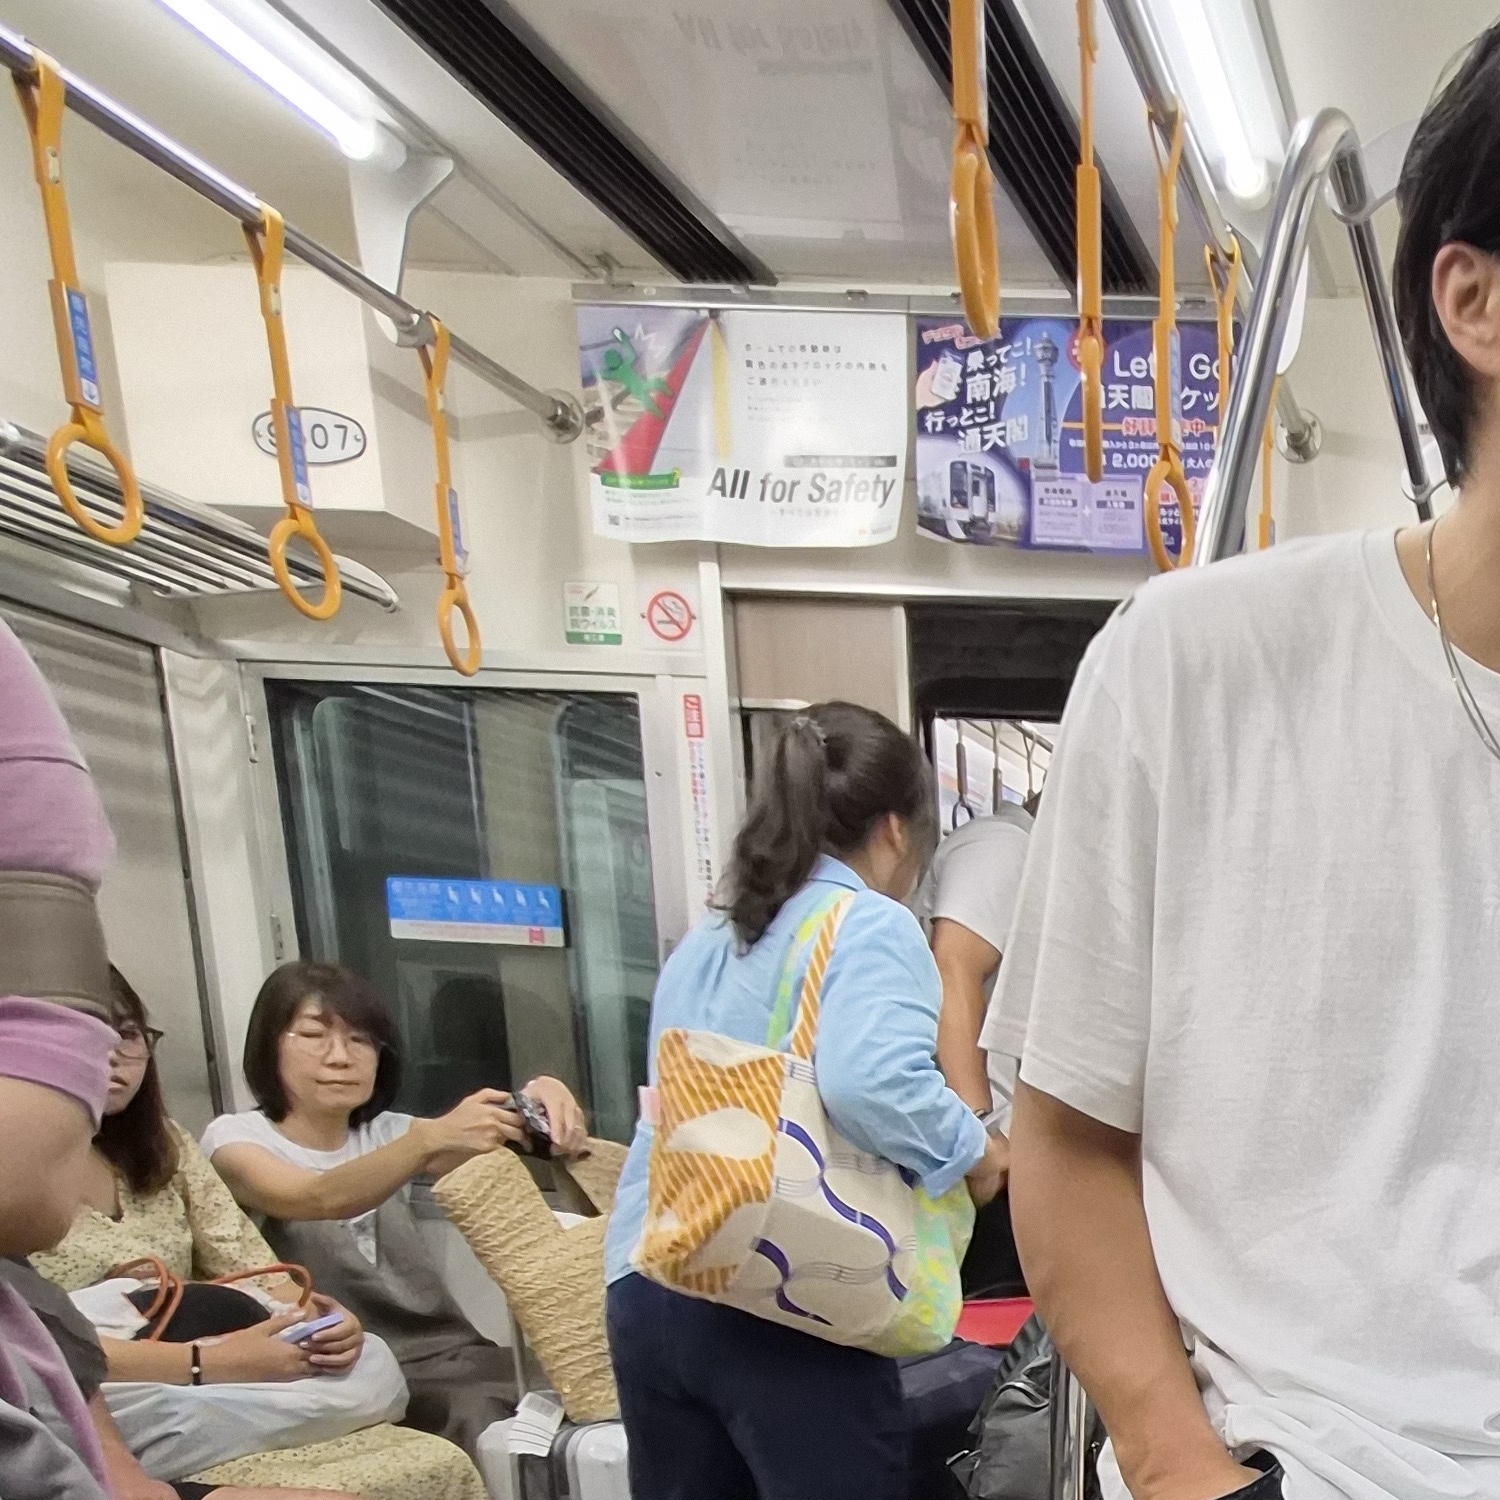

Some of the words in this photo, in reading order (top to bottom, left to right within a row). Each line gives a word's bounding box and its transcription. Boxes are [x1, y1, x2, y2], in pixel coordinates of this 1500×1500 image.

[706, 467, 750, 499] All
[759, 471, 800, 503] for
[807, 472, 896, 508] Safety
